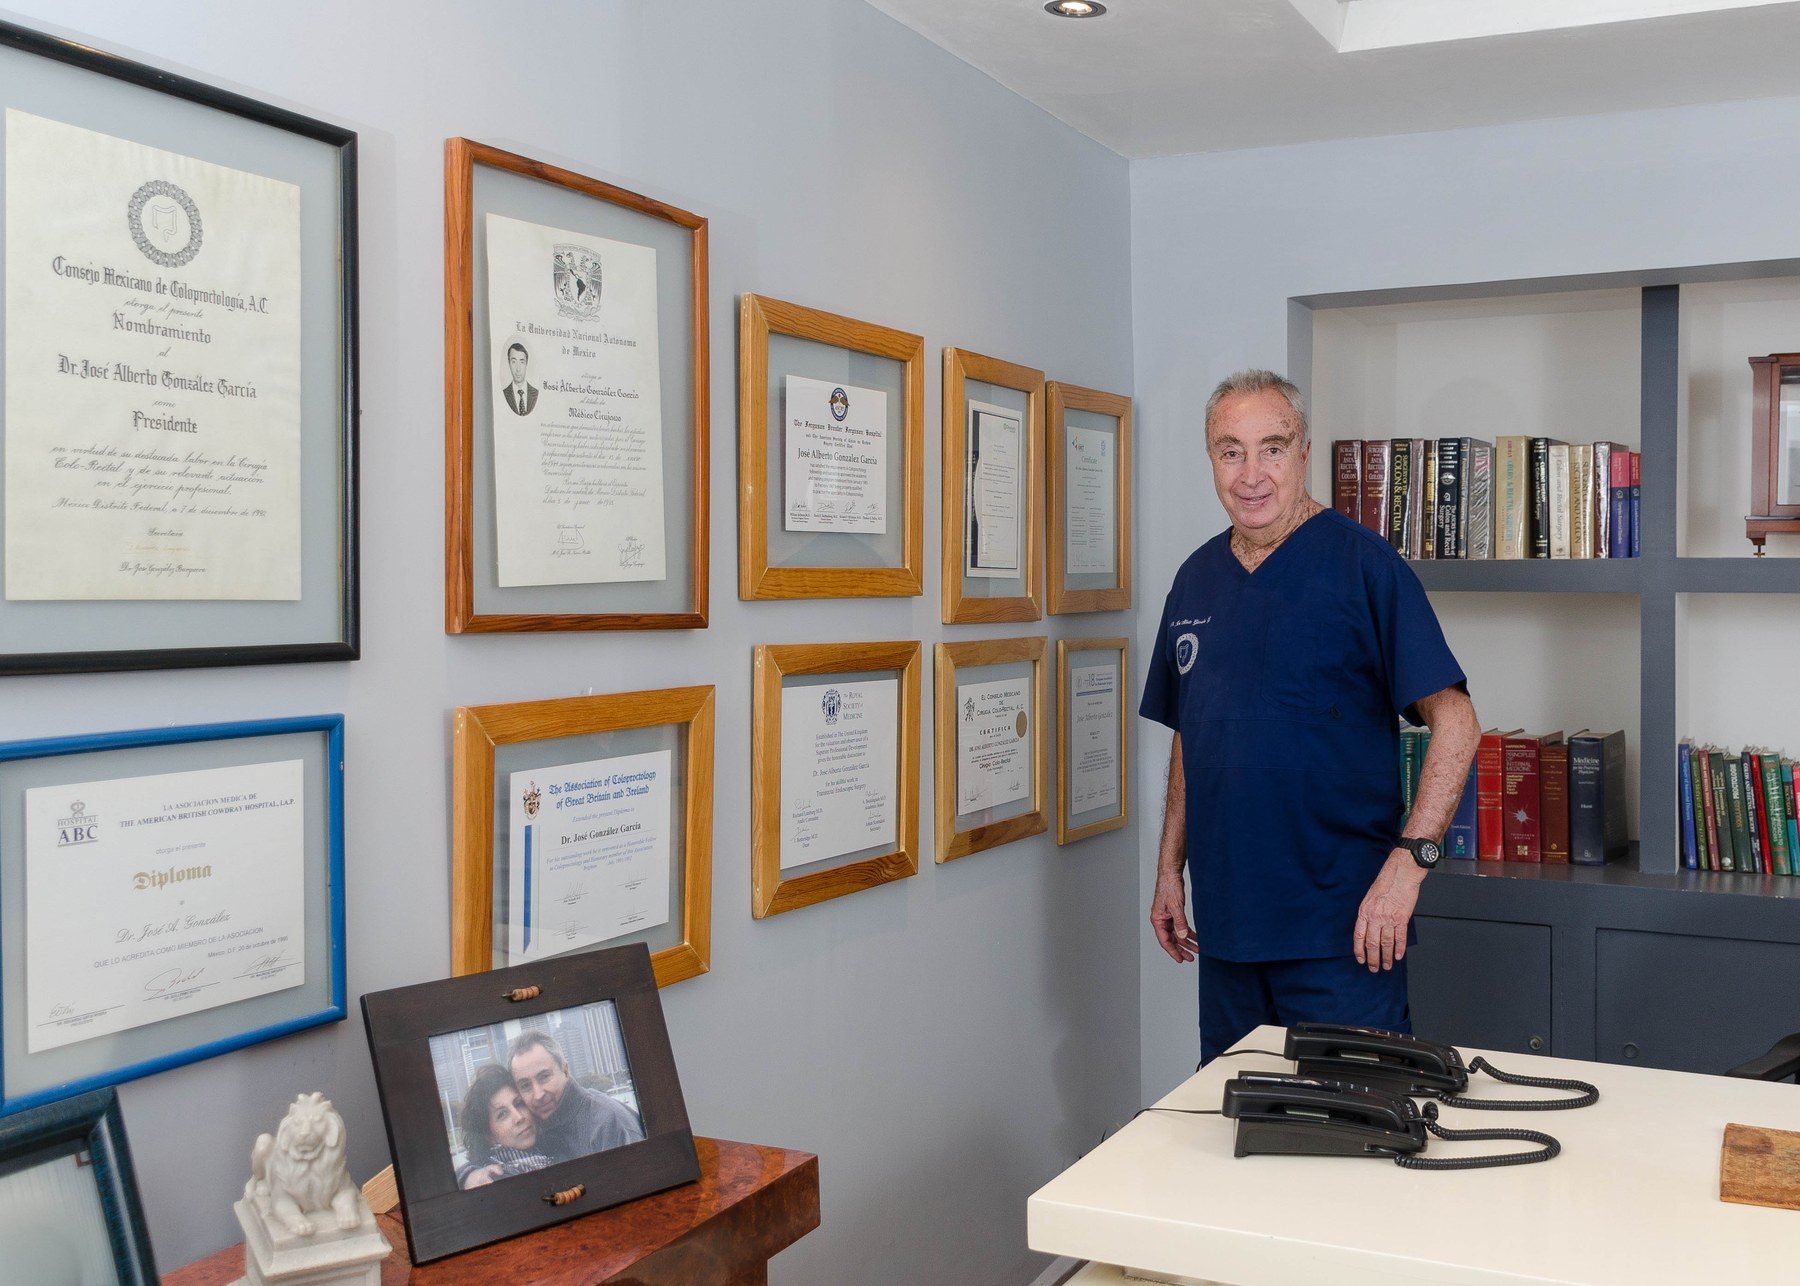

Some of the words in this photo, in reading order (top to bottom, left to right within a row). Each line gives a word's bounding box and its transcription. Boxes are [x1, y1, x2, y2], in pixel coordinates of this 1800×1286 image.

[52, 255, 100, 285] Consejo
[103, 266, 152, 293] Mexicano
[155, 277, 167, 296] de
[249, 296, 269, 315] A.C.
[112, 312, 212, 345] Nombramiento
[516, 321, 526, 332] La
[528, 322, 571, 338] Universidad
[572, 329, 602, 343] Nacional
[562, 346, 570, 355] de
[80, 359, 110, 379] José
[113, 362, 157, 387] Alberto
[161, 370, 214, 394] González
[217, 378, 257, 399] García
[543, 380, 558, 391] José
[560, 379, 586, 394] Alberto
[132, 410, 199, 434] Presidente
[568, 407, 593, 421] Médico
[798, 448, 810, 459] José
[811, 449, 833, 460] Alberto
[1394, 455, 1402, 484] COLON
[1394, 485, 1402, 494] &
[1556, 479, 1564, 492] and
[1393, 495, 1402, 531] RECTUM
[1556, 494, 1564, 513] Rectal
[1573, 496, 1581, 515] AND
[1554, 514, 1564, 541] Surgery
[1573, 516, 1581, 544] COLON
[843, 713, 863, 721] MEDICINE
[979, 725, 1011, 736] CERTIFICA
[549, 784, 562, 795] The
[564, 777, 602, 792] Association
[604, 776, 611, 787] of
[612, 770, 656, 785] Coloproctology
[1730, 763, 1740, 799] PROCTOLOGIE
[174, 798, 218, 811] ASOCIACION
[219, 795, 247, 807] MEDICA
[248, 793, 257, 801] DE
[556, 799, 564, 809] of
[565, 796, 585, 807] Great
[587, 790, 611, 803] Britain
[613, 787, 624, 798] and
[625, 785, 650, 796] Ireland
[57, 816, 98, 828] HOSPITAL
[120, 819, 135, 829] THE
[137, 814, 177, 828] AMERICAN
[178, 810, 207, 822] BRITISH
[208, 806, 242, 818] COWDRAY
[57, 825, 98, 845] ABC
[561, 835, 572, 845] Dr.
[573, 831, 588, 842] José
[589, 827, 619, 839] González
[620, 821, 641, 833] García
[132, 864, 213, 892] Diploma
[115, 927, 136, 945] Dr.
[137, 921, 164, 944] José
[183, 910, 232, 932] González
[94, 959, 109, 969] QUE
[110, 957, 120, 966] LO
[121, 949, 155, 964] ACREDITA
[156, 945, 177, 956] COMO
[177, 939, 208, 953] MIEMBRO
[208, 936, 217, 945] DE
[218, 934, 226, 943] LA
[226, 927, 264, 941] ASOCIACION
